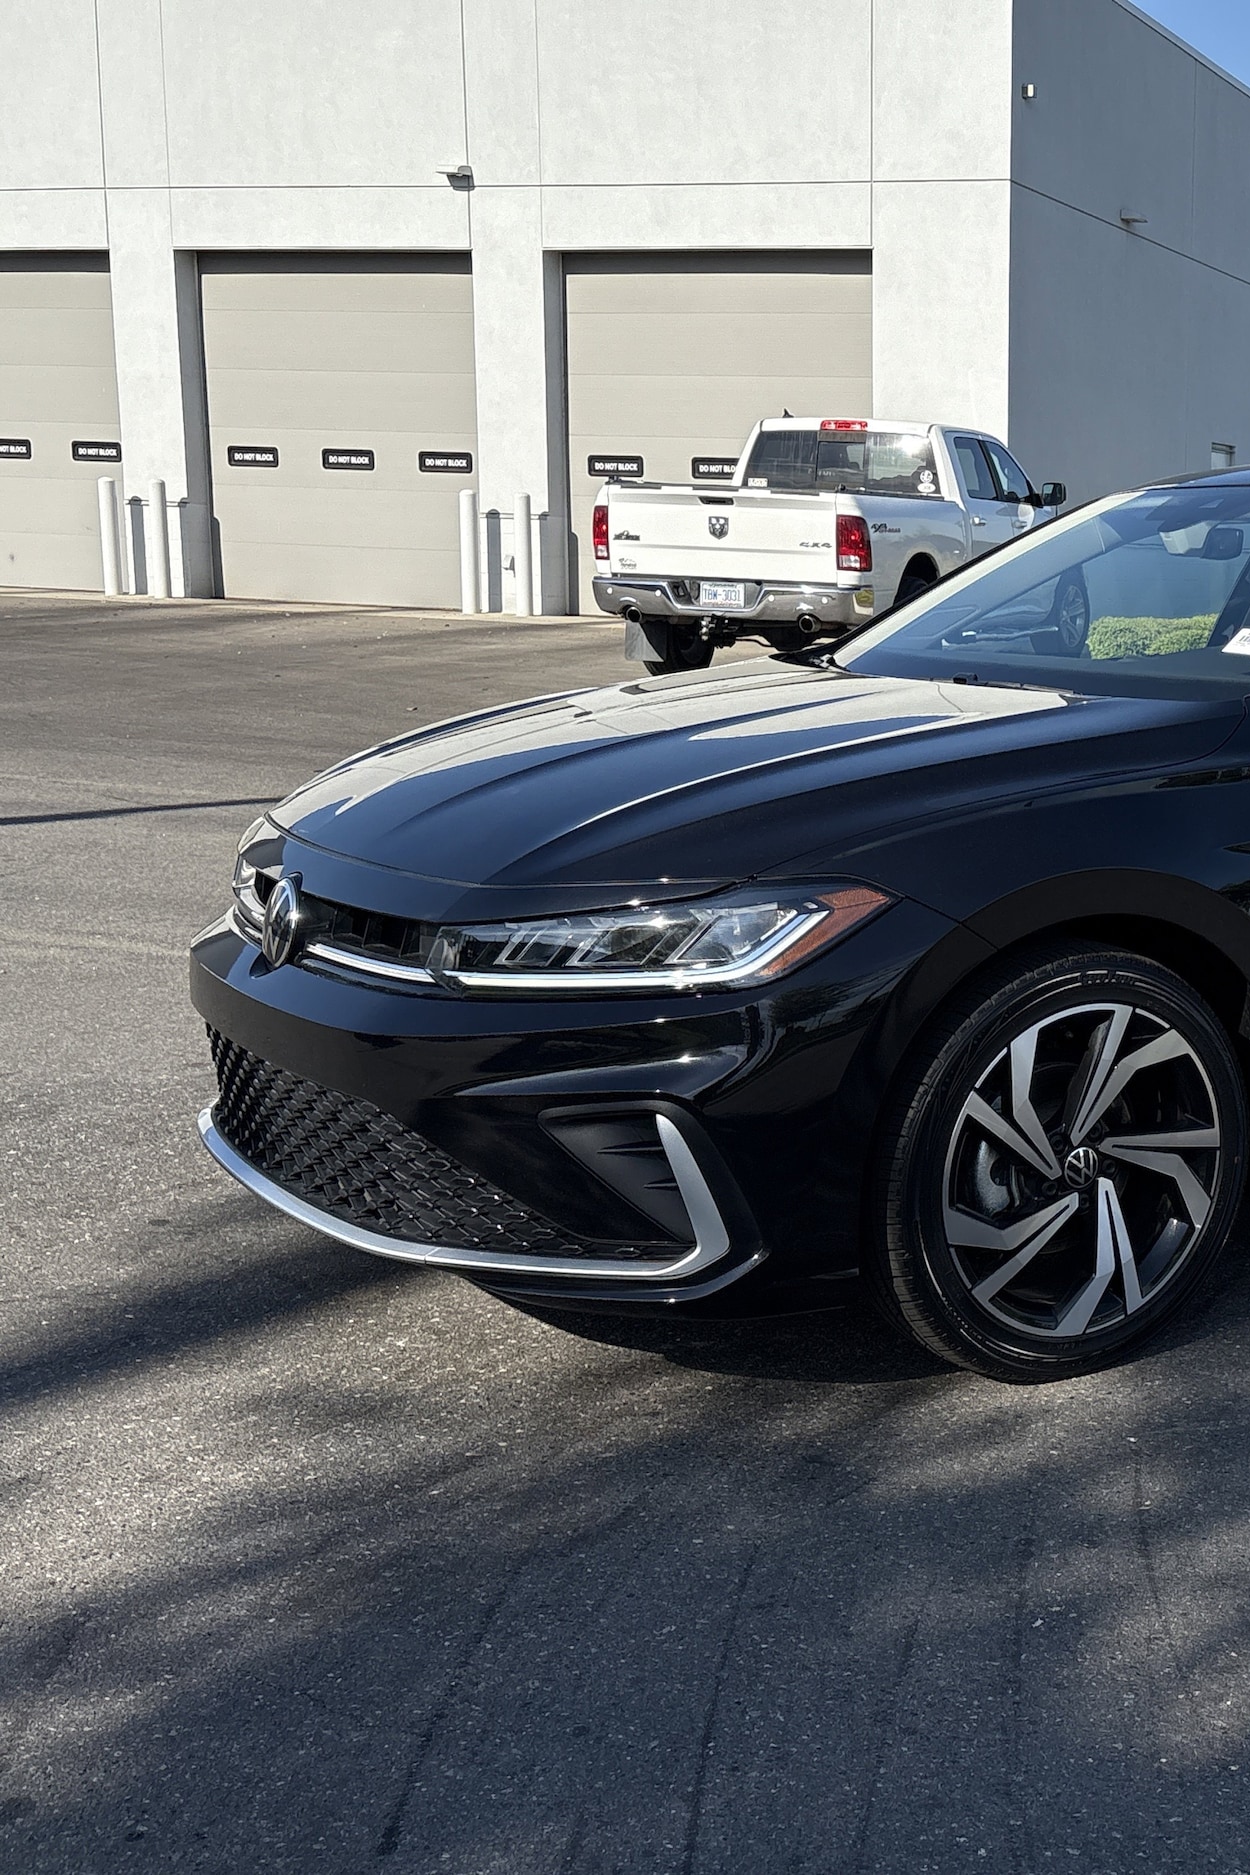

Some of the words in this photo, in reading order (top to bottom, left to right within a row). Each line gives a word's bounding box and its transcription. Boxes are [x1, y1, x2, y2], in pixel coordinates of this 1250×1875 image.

[87, 448, 99, 456] NOT
[99, 448, 117, 456] BLOCK
[243, 453, 255, 461] NOT
[255, 453, 274, 461] BLOCK
[328, 455, 337, 463] DO
[338, 456, 350, 464] NOT
[350, 456, 369, 464] BLOCK
[425, 458, 434, 466] DO
[448, 459, 467, 467] BLOCK
[594, 462, 604, 470] DO
[605, 463, 617, 471] NOT
[618, 463, 638, 471] BLOCK
[709, 465, 723, 473] NOT
[723, 465, 737, 473] BLO
